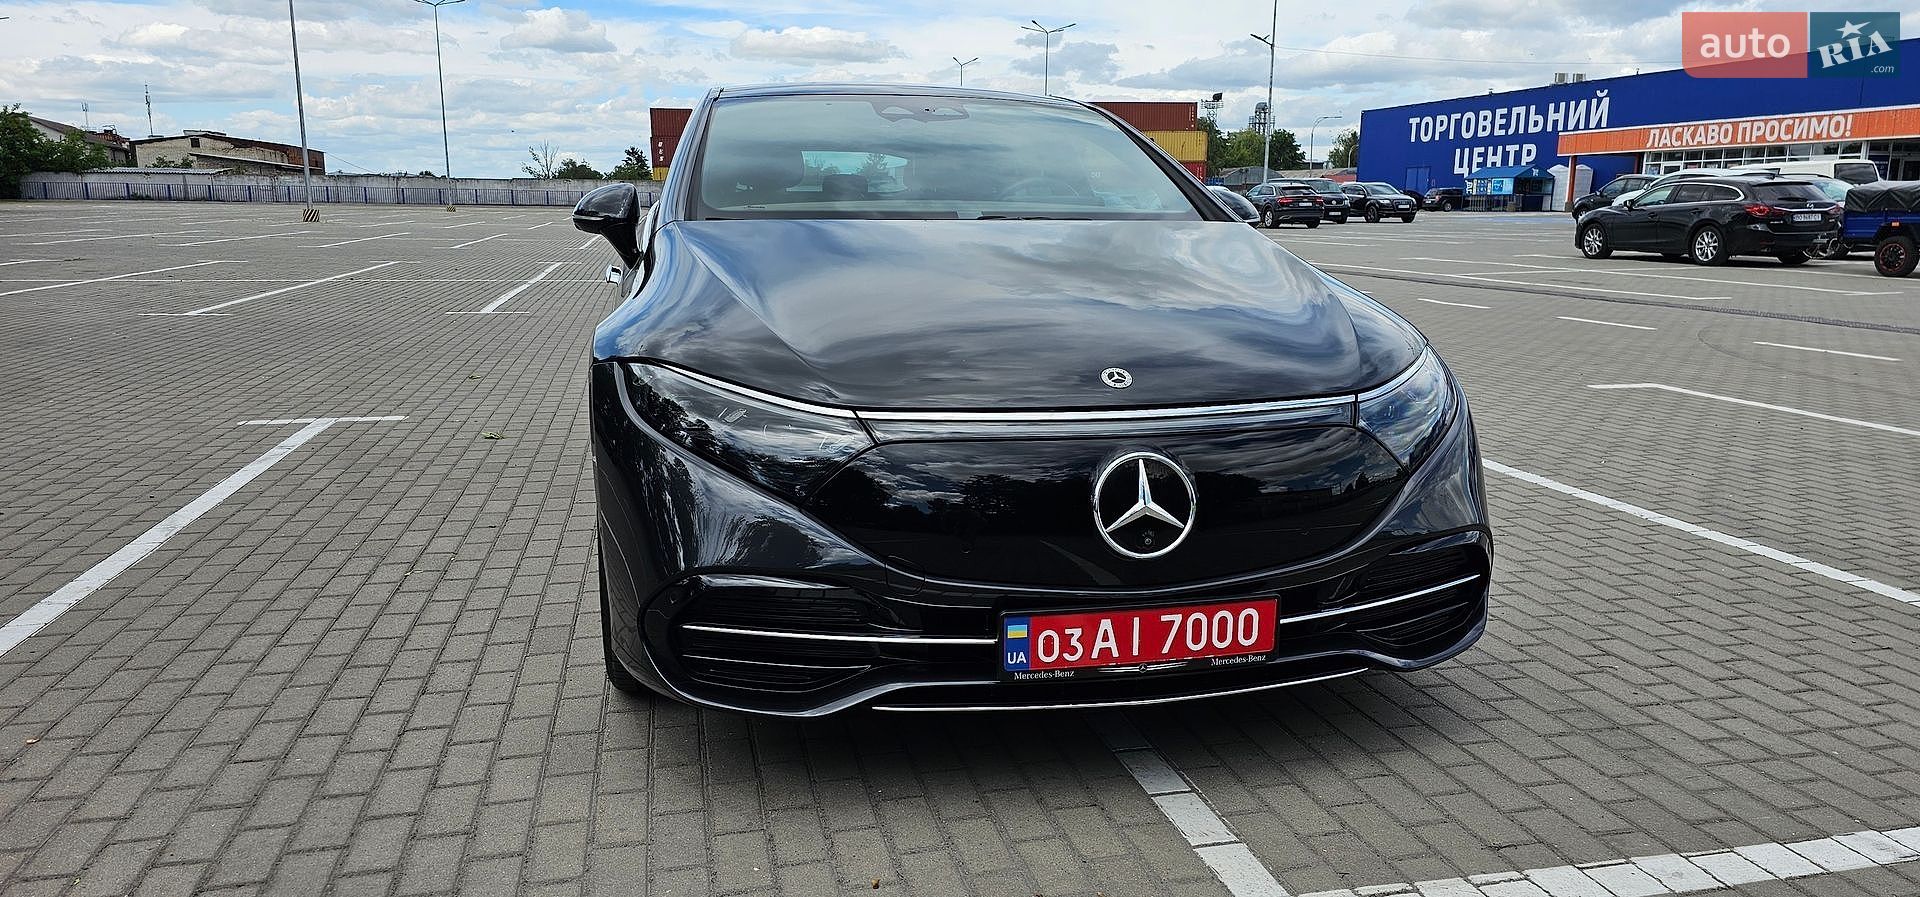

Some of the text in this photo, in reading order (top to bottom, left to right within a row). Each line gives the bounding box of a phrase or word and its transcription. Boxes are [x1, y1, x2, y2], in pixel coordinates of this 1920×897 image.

[1408, 89, 1610, 143] ТОРГОВЕЛЬНИЙ
[1646, 115, 1853, 148] ЛАСКАВО ПРОСИМО!
[1453, 143, 1537, 178] ЦЕНТР
[1160, 608, 1259, 654] 7000
[1007, 651, 1027, 664] UA
[1211, 654, 1266, 666] Mercedes-Benz
[1014, 670, 1075, 680] Mercedes-Benz
